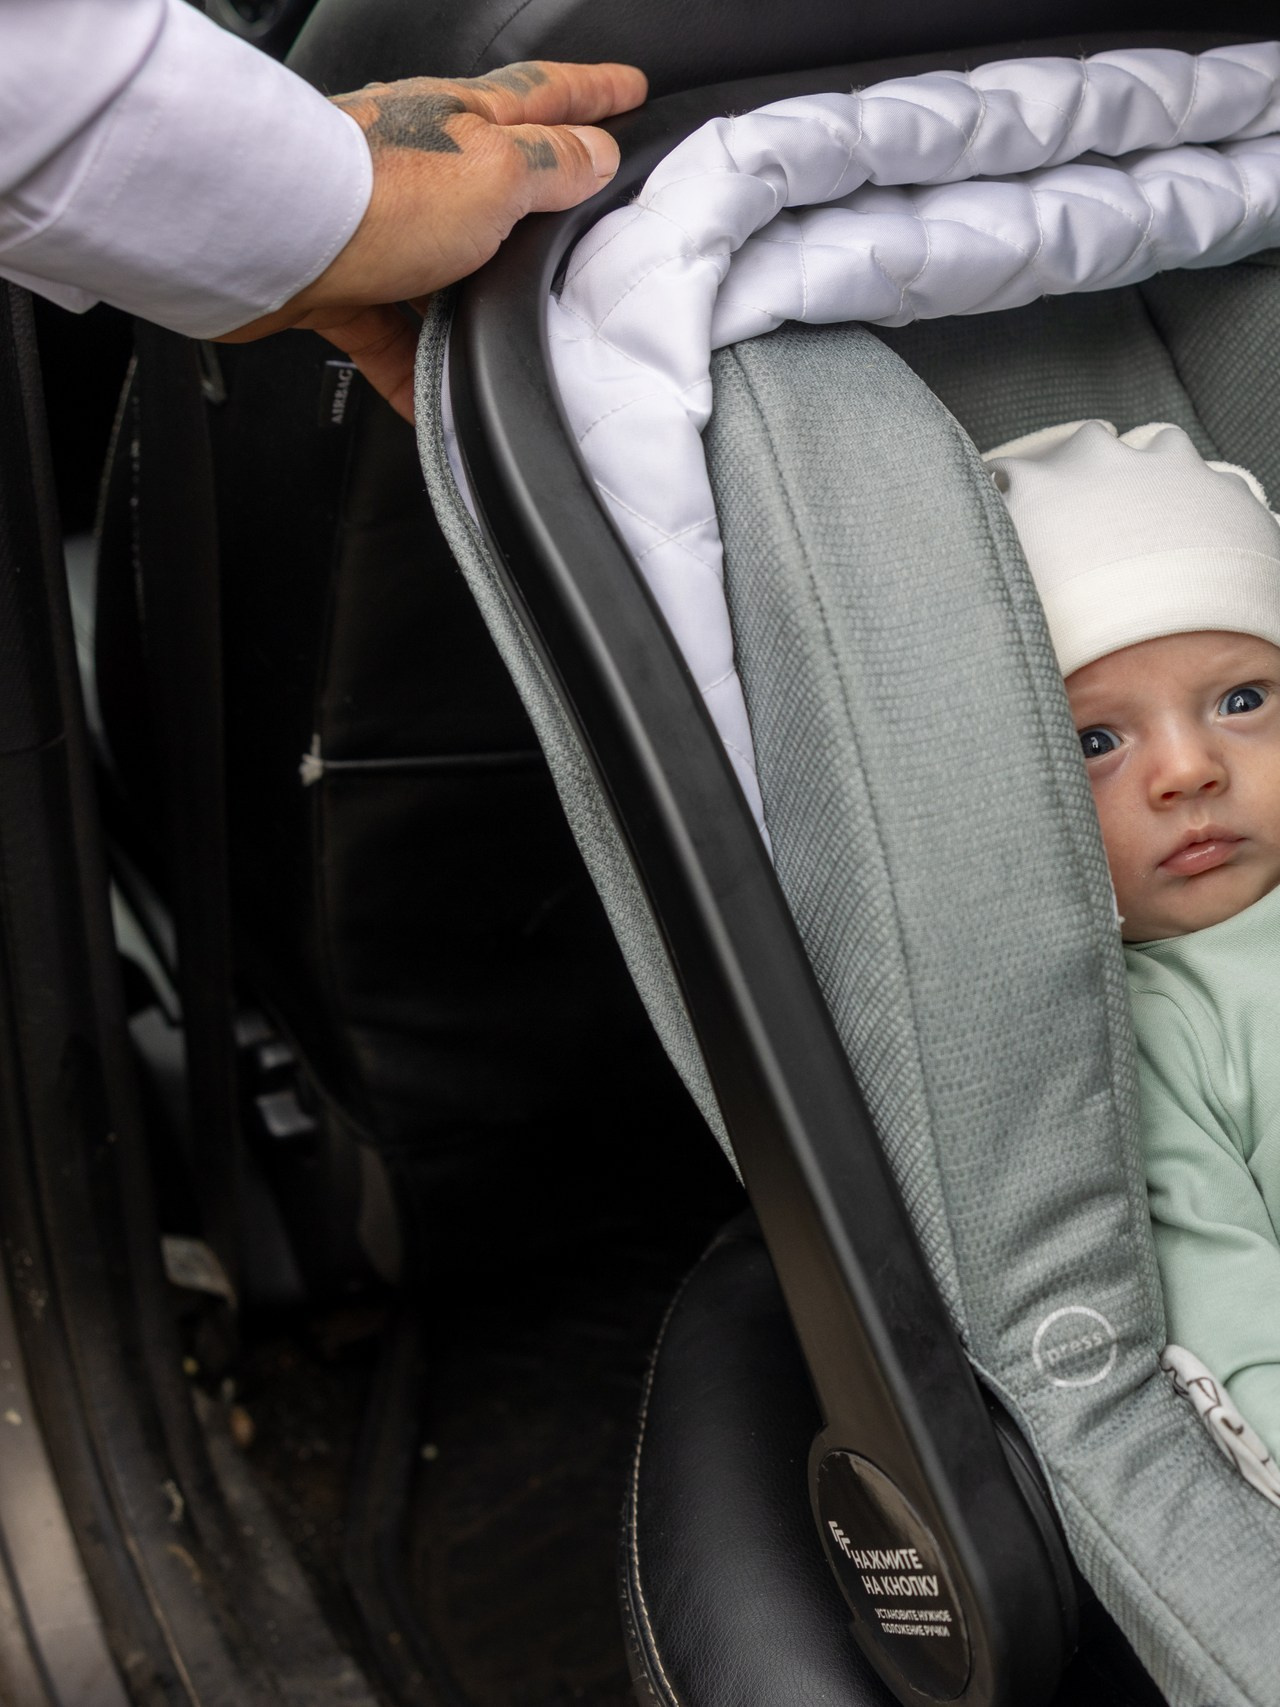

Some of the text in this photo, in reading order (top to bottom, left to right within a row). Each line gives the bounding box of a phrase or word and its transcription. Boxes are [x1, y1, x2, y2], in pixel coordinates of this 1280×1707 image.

[331, 368, 353, 424] AIRBAG
[1046, 1332, 1103, 1367] press
[850, 1548, 923, 1570] НАЖМИТЕ
[861, 1574, 940, 1597] НА КНОПКУ
[874, 1607, 919, 1621] УСТАНОВИТЕ
[881, 1622, 926, 1636] ПОЛОЖЕНИЕ
